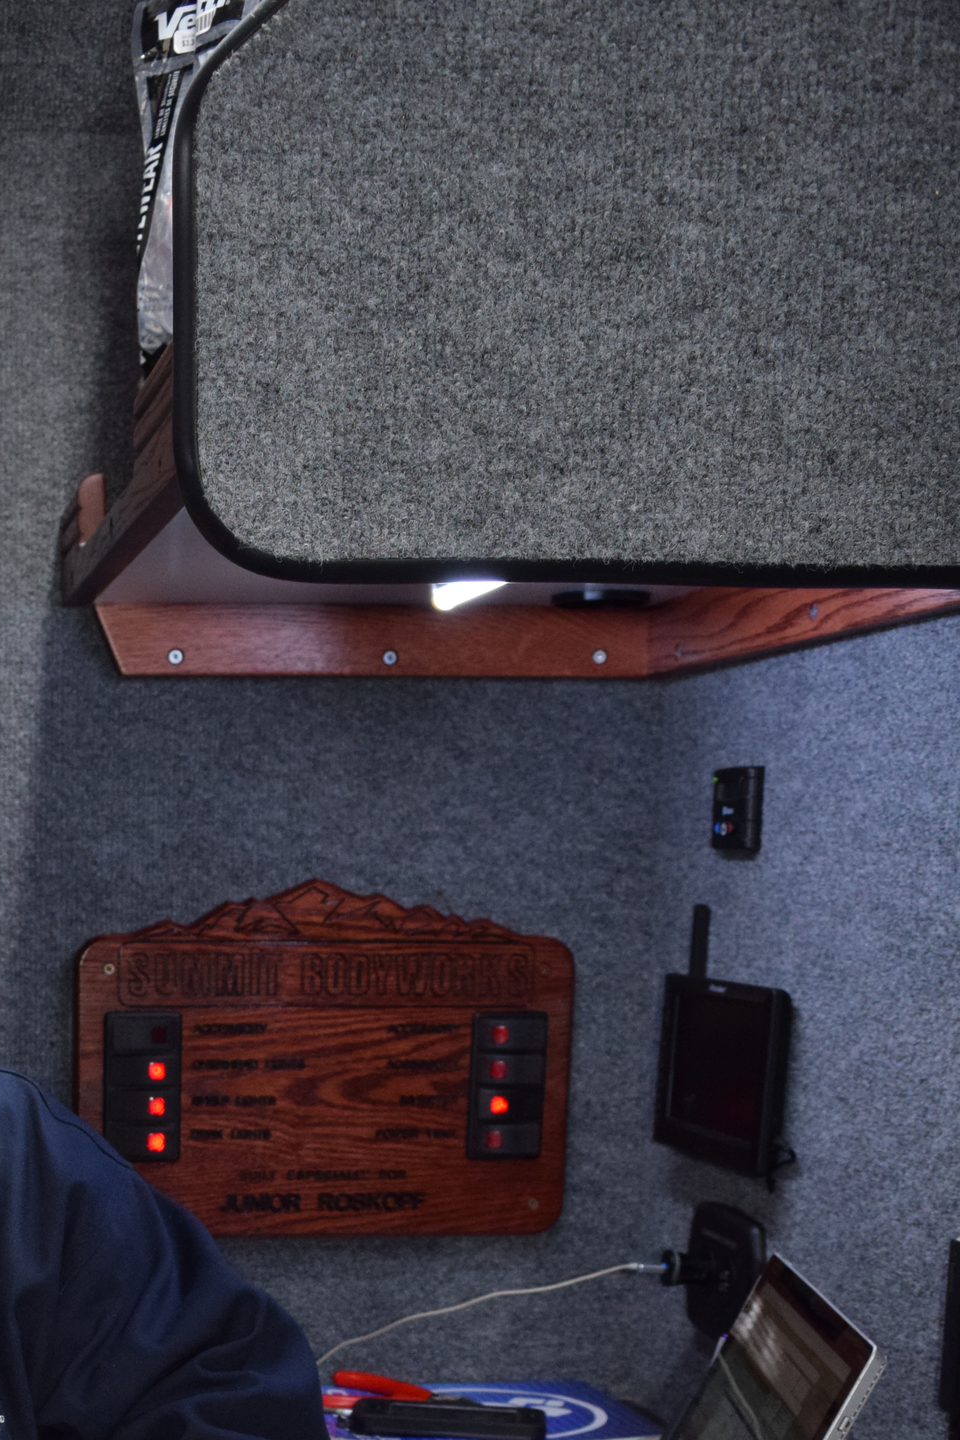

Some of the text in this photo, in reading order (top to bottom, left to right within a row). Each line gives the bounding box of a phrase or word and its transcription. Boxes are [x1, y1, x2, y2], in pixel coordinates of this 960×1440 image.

[127, 951, 532, 998] SUMMIT BODYWORKS
[220, 1191, 427, 1213] JUNIOR ROSKOFF
